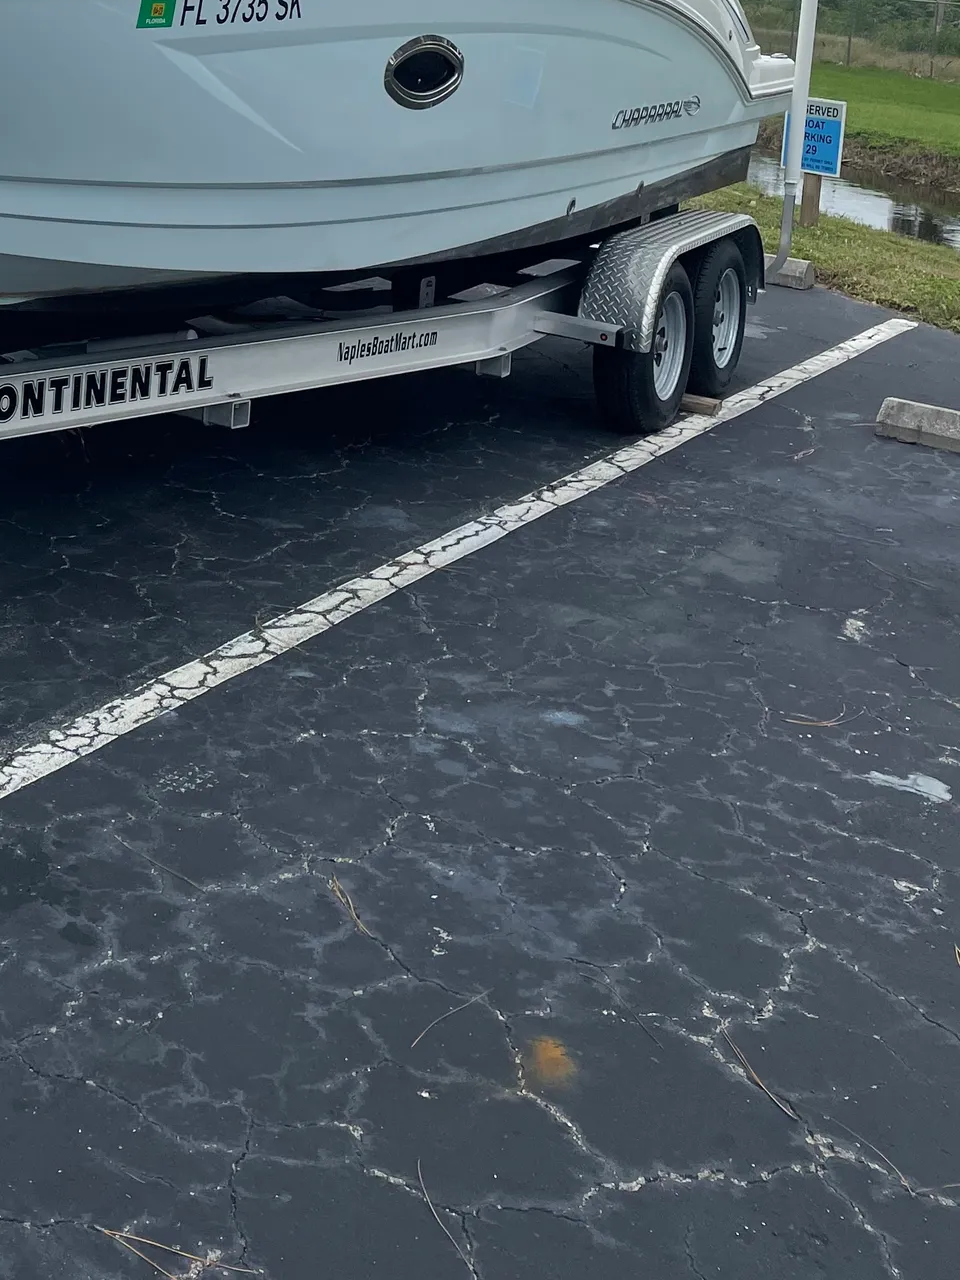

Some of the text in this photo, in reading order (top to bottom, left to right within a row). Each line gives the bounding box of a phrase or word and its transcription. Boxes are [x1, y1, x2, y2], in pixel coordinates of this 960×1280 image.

[806, 104, 839, 118] ERVED
[804, 119, 826, 130] OAT
[804, 131, 832, 144] RKING
[805, 144, 817, 155] 29
[337, 331, 438, 365] NaplesBoatMart.com
